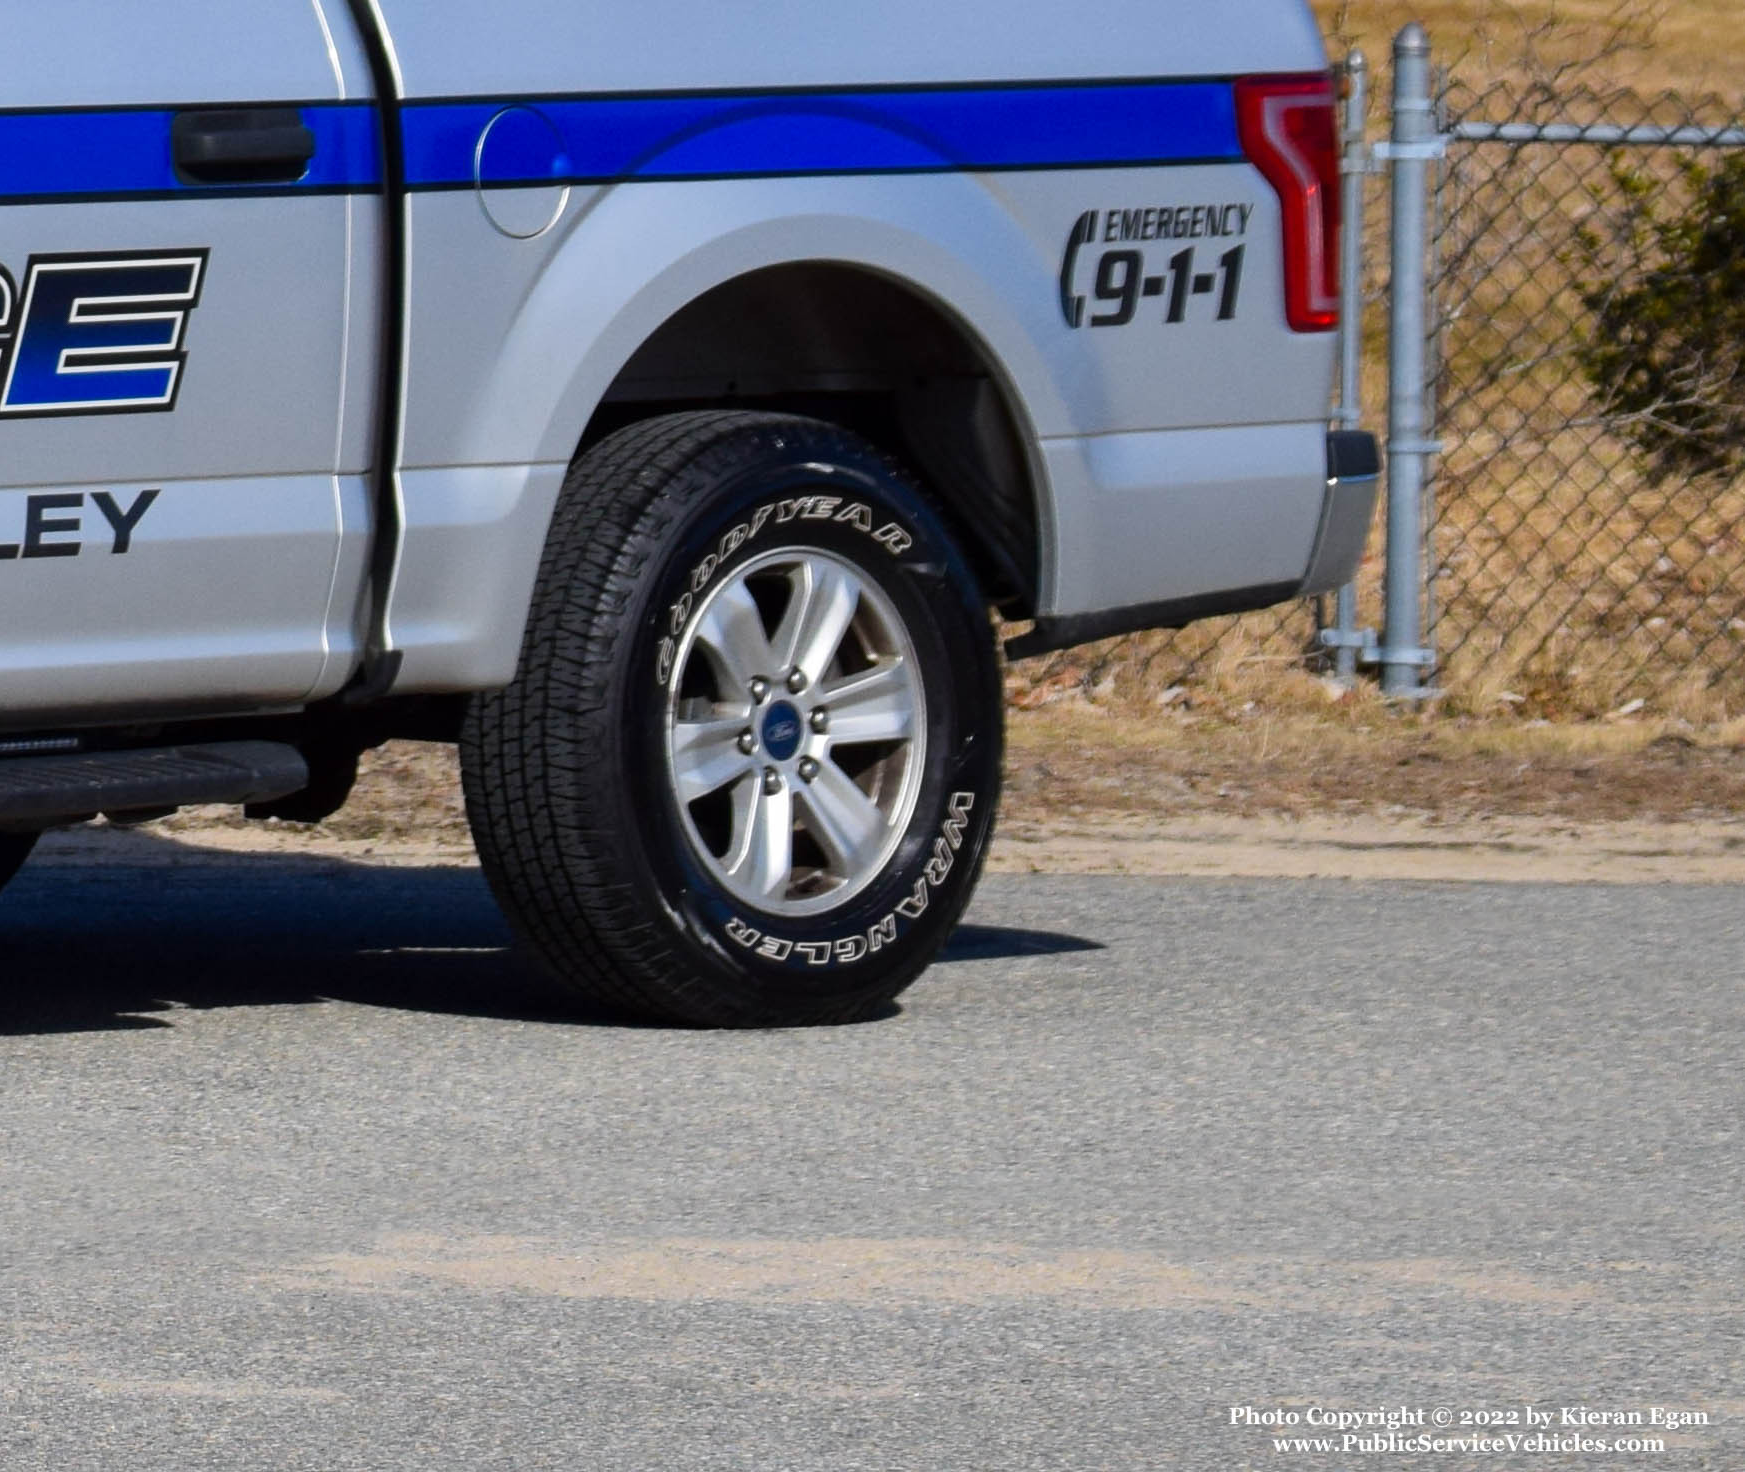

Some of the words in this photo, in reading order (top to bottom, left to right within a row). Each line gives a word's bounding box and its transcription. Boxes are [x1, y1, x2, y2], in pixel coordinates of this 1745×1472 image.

[1090, 243, 1247, 327] 9-1-1
[1103, 203, 1255, 243] EMERGENCY
[656, 495, 913, 686] GOODYEAR
[725, 792, 975, 965] WRANGLER
